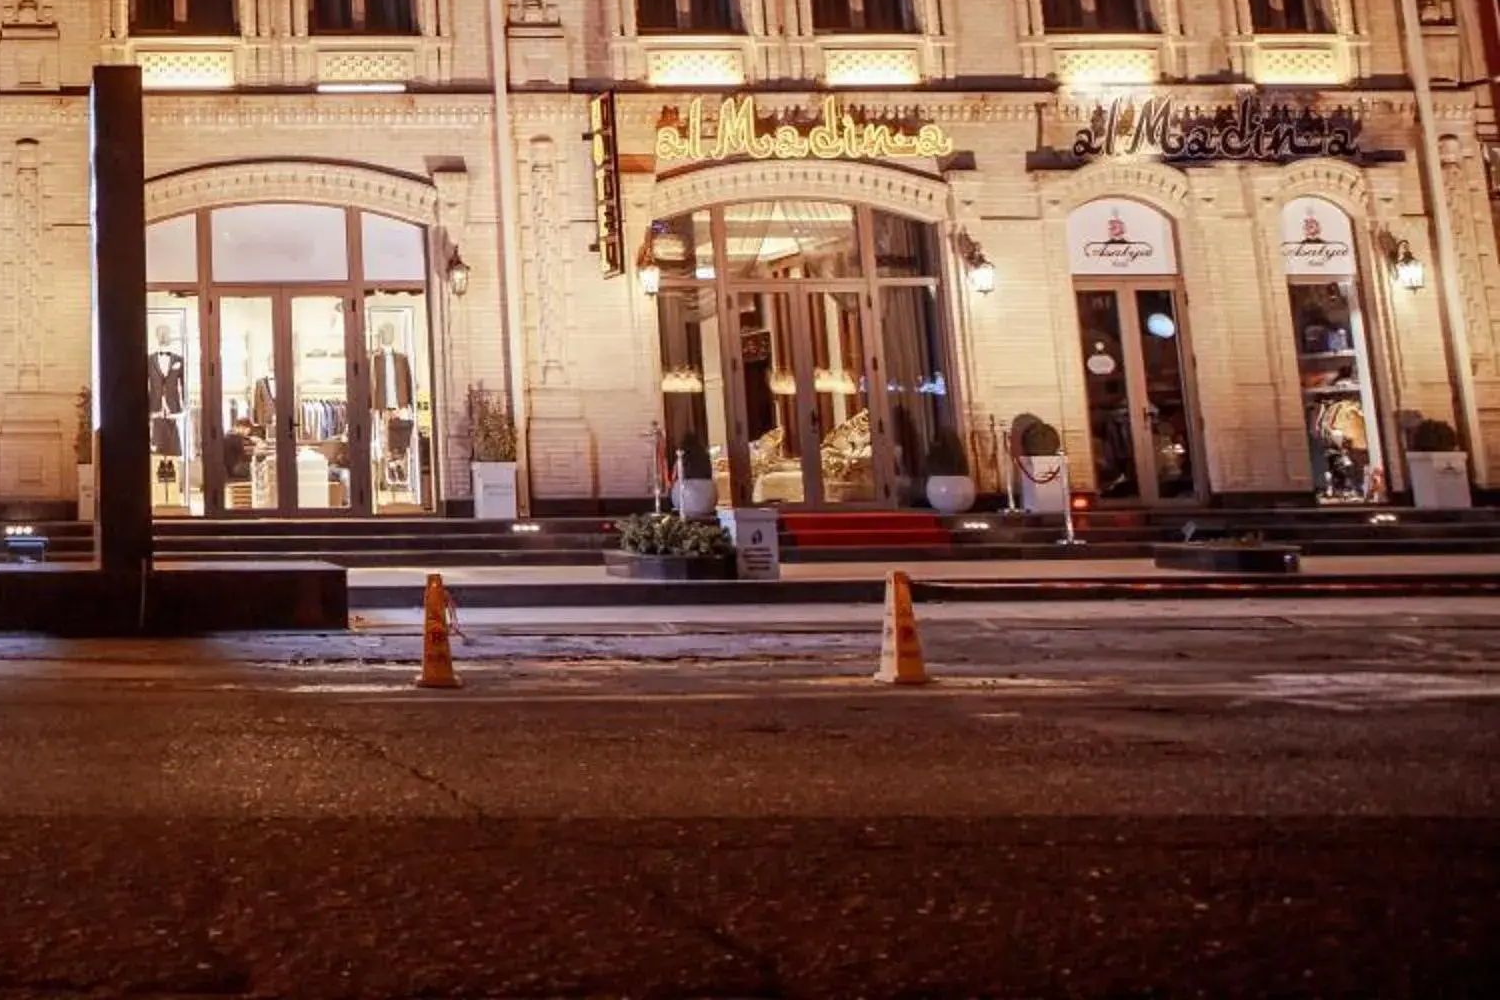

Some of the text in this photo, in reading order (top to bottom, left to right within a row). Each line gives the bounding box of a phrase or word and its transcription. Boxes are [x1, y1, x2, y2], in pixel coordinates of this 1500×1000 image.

[655, 95, 954, 160] al Madina
[1073, 94, 1362, 160] al Madina
